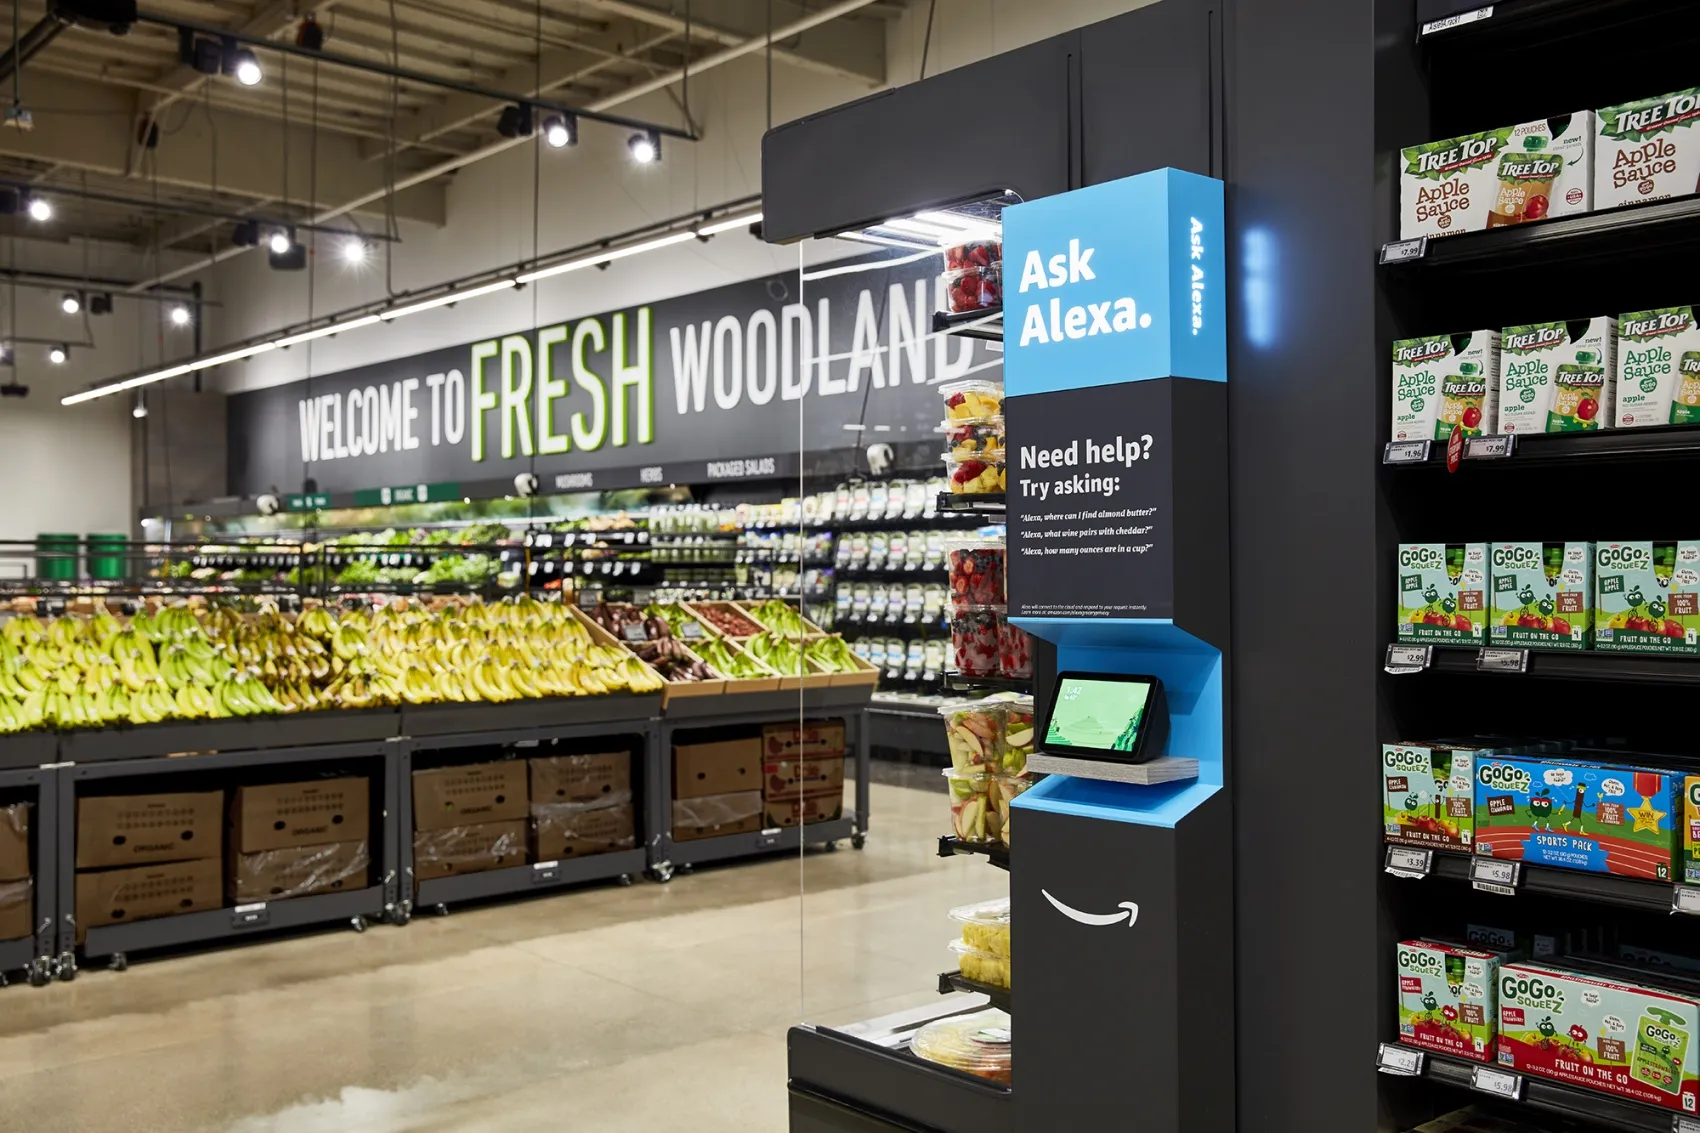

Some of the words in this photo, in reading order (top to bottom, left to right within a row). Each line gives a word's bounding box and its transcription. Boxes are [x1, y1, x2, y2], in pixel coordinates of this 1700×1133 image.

[1615, 105, 1664, 134] TREE
[1514, 129, 1520, 137] 12
[1520, 123, 1547, 136] POUCHES
[1563, 135, 1582, 145] new!
[1417, 149, 1458, 173] TREE
[1459, 137, 1498, 160] TOP
[1612, 138, 1676, 169] Apple
[1501, 162, 1532, 176] TREE
[1532, 160, 1560, 174] TOP
[1613, 159, 1676, 189] Sauce
[1415, 178, 1470, 205] Apple
[1500, 187, 1526, 199] Apple
[1498, 196, 1524, 206] Sauce
[1416, 196, 1470, 223] Sauce
[1190, 216, 1204, 260] Ask
[1401, 247, 1418, 256] $7.99
[1018, 238, 1096, 294] Ask
[1190, 264, 1205, 336] Alexa.
[1019, 297, 1152, 347] Alexa.
[1624, 320, 1657, 337] TREE
[1657, 313, 1689, 328] TOP
[1506, 334, 1537, 349] TREE
[1537, 327, 1564, 342] TOP
[1585, 336, 1602, 344] new!
[1396, 346, 1424, 361] TREE
[1424, 340, 1449, 355] TOP
[1467, 348, 1483, 356] new!
[1624, 346, 1672, 366] Apple
[1505, 359, 1549, 377] Apple
[1624, 363, 1671, 381] Sauce
[1397, 370, 1436, 388] Apple
[1505, 373, 1548, 391] Sauce
[1558, 371, 1583, 383] TREE
[1582, 371, 1604, 383] TOP
[299, 378, 419, 463] WELCOME
[426, 368, 466, 445] TO
[470, 306, 654, 462] FRESH
[1445, 382, 1468, 394] TREE
[1397, 385, 1436, 401] Sauce
[1622, 394, 1645, 403] apple
[1504, 404, 1525, 412] apple
[1397, 414, 1415, 422] apple
[1020, 440, 1078, 469] Need
[1086, 434, 1153, 468] help?
[1405, 450, 1422, 458] $1.96
[1486, 445, 1505, 453] $7.99
[707, 460, 744, 478] PACKAGED
[744, 458, 775, 475] SALADS
[1020, 479, 1050, 501] Try
[1054, 472, 1120, 497] asking:
[1044, 512, 1064, 521] where
[1077, 512, 1082, 520] I
[1081, 510, 1097, 520] find
[1098, 509, 1125, 518] almond
[1044, 530, 1061, 538] what
[1062, 529, 1078, 538] wine
[1079, 528, 1097, 538] pairs
[1098, 527, 1114, 536] with
[1044, 547, 1058, 555] how
[1059, 547, 1079, 556] many
[1079, 546, 1104, 554] ounces
[1104, 545, 1117, 553] are
[1117, 544, 1125, 553] in
[1126, 545, 1131, 553] a
[1400, 548, 1437, 567] GoGo
[1493, 547, 1533, 567] GoGo
[1598, 546, 1642, 567] GoGo
[1411, 560, 1442, 570] SQUEEZ
[1505, 560, 1538, 570] SQUEEZ
[1610, 560, 1648, 570] SQUEEZ
[1563, 597, 1576, 605] 100%
[1677, 599, 1691, 607] 100%
[1619, 635, 1638, 643] FRUIT
[1407, 654, 1424, 662] $2.99
[1384, 750, 1422, 768] GoGo
[1395, 764, 1428, 774] SQUEEZ
[1479, 765, 1523, 784] GoGo
[1492, 781, 1529, 792] SQUEEZ
[1453, 801, 1465, 809] 100%
[1489, 798, 1506, 806] APPLE
[1451, 806, 1466, 814] FRUIT
[1605, 806, 1617, 814] 100%
[1602, 813, 1619, 821] FRUIT
[1406, 831, 1422, 839] FRUIT
[1431, 833, 1442, 841] THE
[133, 843, 175, 853] ORGANIC
[1536, 835, 1568, 847] SPORTS
[1572, 840, 1592, 852] PACK
[1407, 858, 1424, 867] $3.39
[1492, 869, 1511, 879] $5.98
[1657, 867, 1667, 878] 12
[1399, 951, 1436, 967] GoGo
[1409, 965, 1441, 977] SQUEEZ
[1502, 976, 1555, 1000] GoGo
[1517, 995, 1563, 1015] SQUEEZ
[1466, 1009, 1478, 1018] 100%
[1464, 1016, 1479, 1024] FRUIT
[1420, 1032, 1435, 1042] FRUIT
[1445, 1038, 1455, 1047] THE
[1455, 1039, 1463, 1048] GO
[1603, 1050, 1620, 1060] FRUIT
[1605, 1045, 1618, 1053] 100%
[1398, 1058, 1415, 1068] $2.29
[1555, 1059, 1579, 1073] FRUIT
[1582, 1064, 1594, 1076] ON
[1597, 1068, 1612, 1081] THE
[1616, 1073, 1628, 1085] GO
[1494, 1081, 1513, 1092] $5.98
[1684, 1096, 1694, 1109] 12
